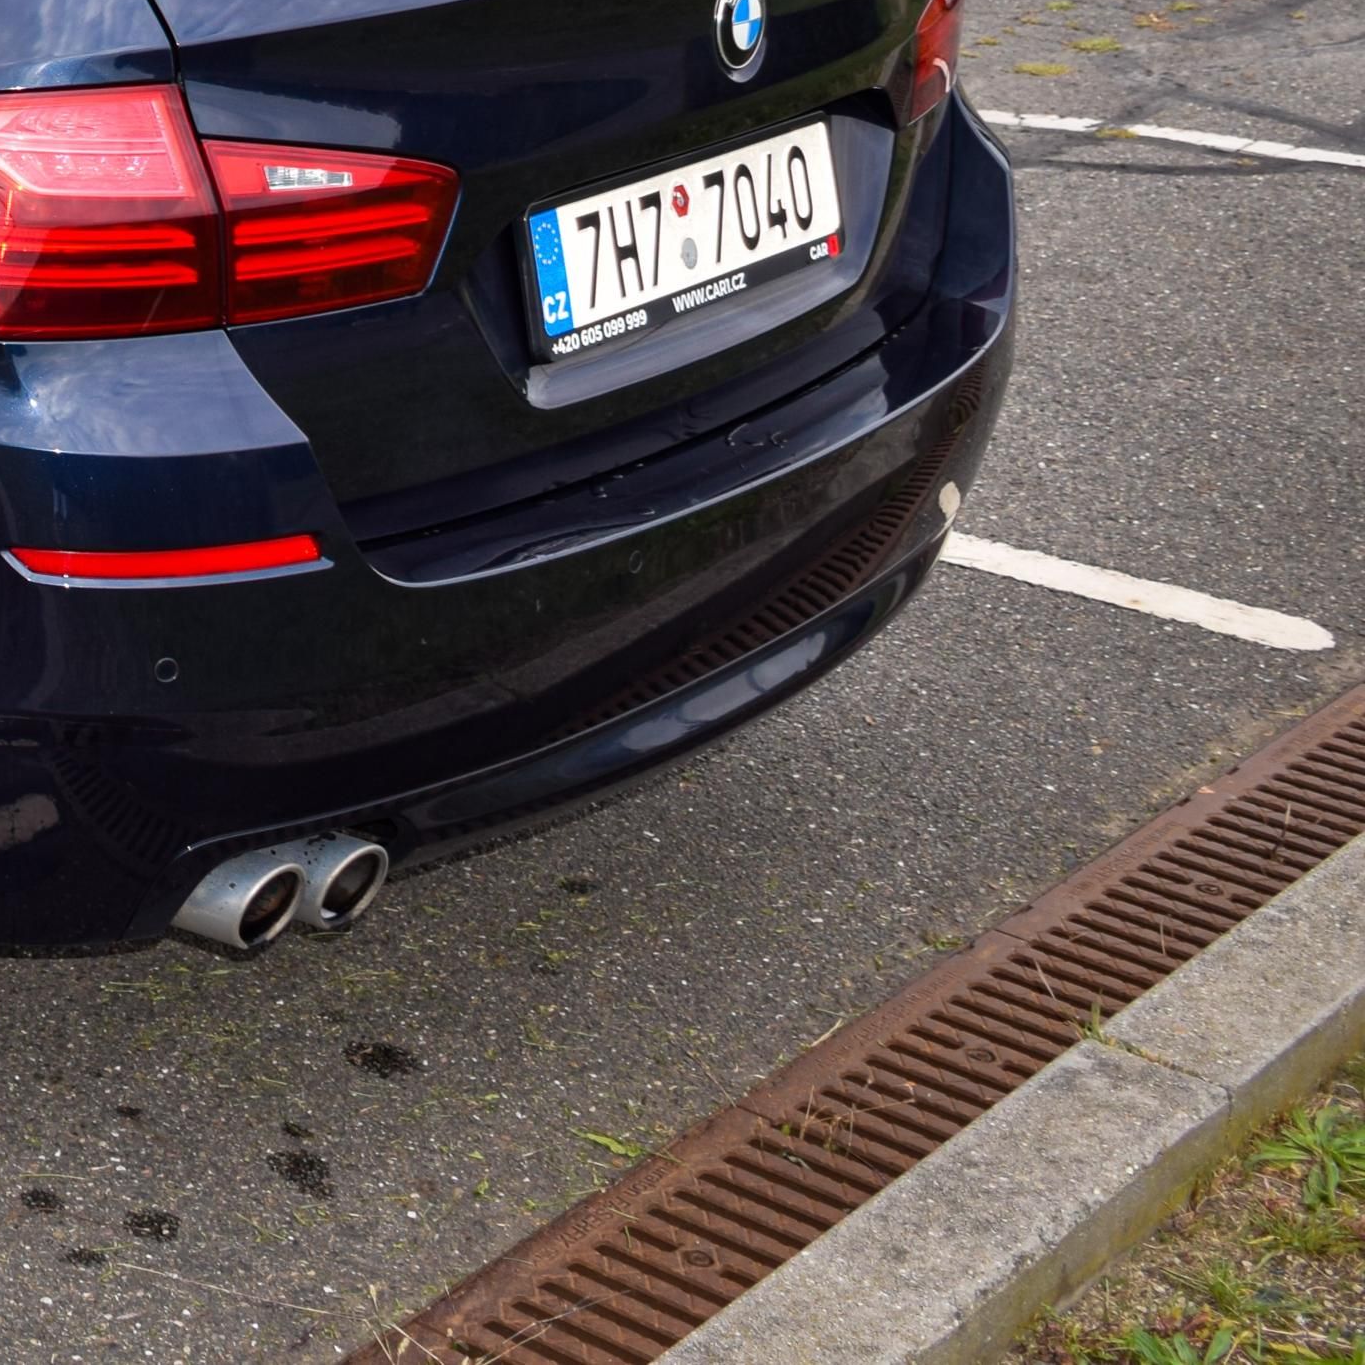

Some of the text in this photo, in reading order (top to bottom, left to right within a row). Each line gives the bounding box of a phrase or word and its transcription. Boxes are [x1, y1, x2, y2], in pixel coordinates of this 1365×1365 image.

[575, 145, 814, 310] 7H7 7040
[543, 290, 569, 324] CZ
[672, 272, 747, 313] WWW.CAR1.CZ
[551, 308, 648, 355] +420 605 099 999
